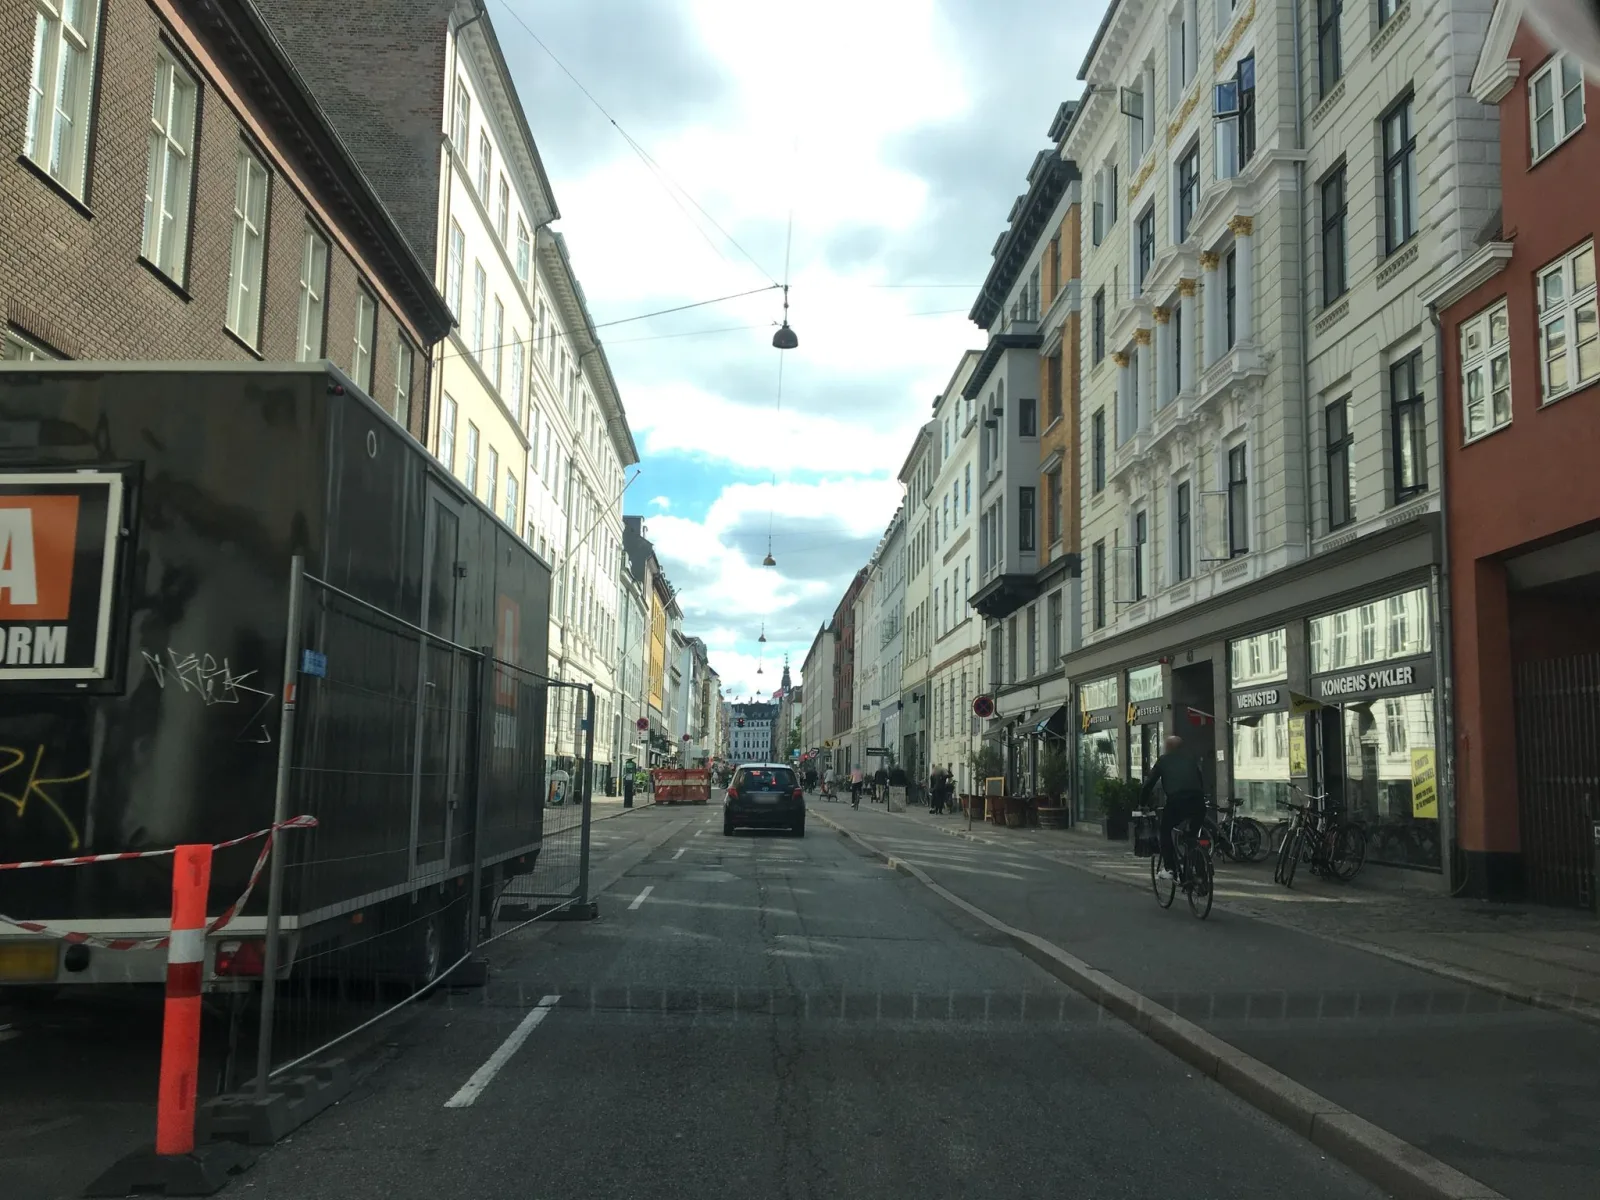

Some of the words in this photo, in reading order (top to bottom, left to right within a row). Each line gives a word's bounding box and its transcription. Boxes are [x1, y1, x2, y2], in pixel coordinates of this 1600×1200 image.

[0, 625, 68, 665] RM
[1321, 674, 1367, 697] KONGENS
[1368, 666, 1413, 690] CYKLER
[1236, 689, 1277, 709] VÆRKSTED
